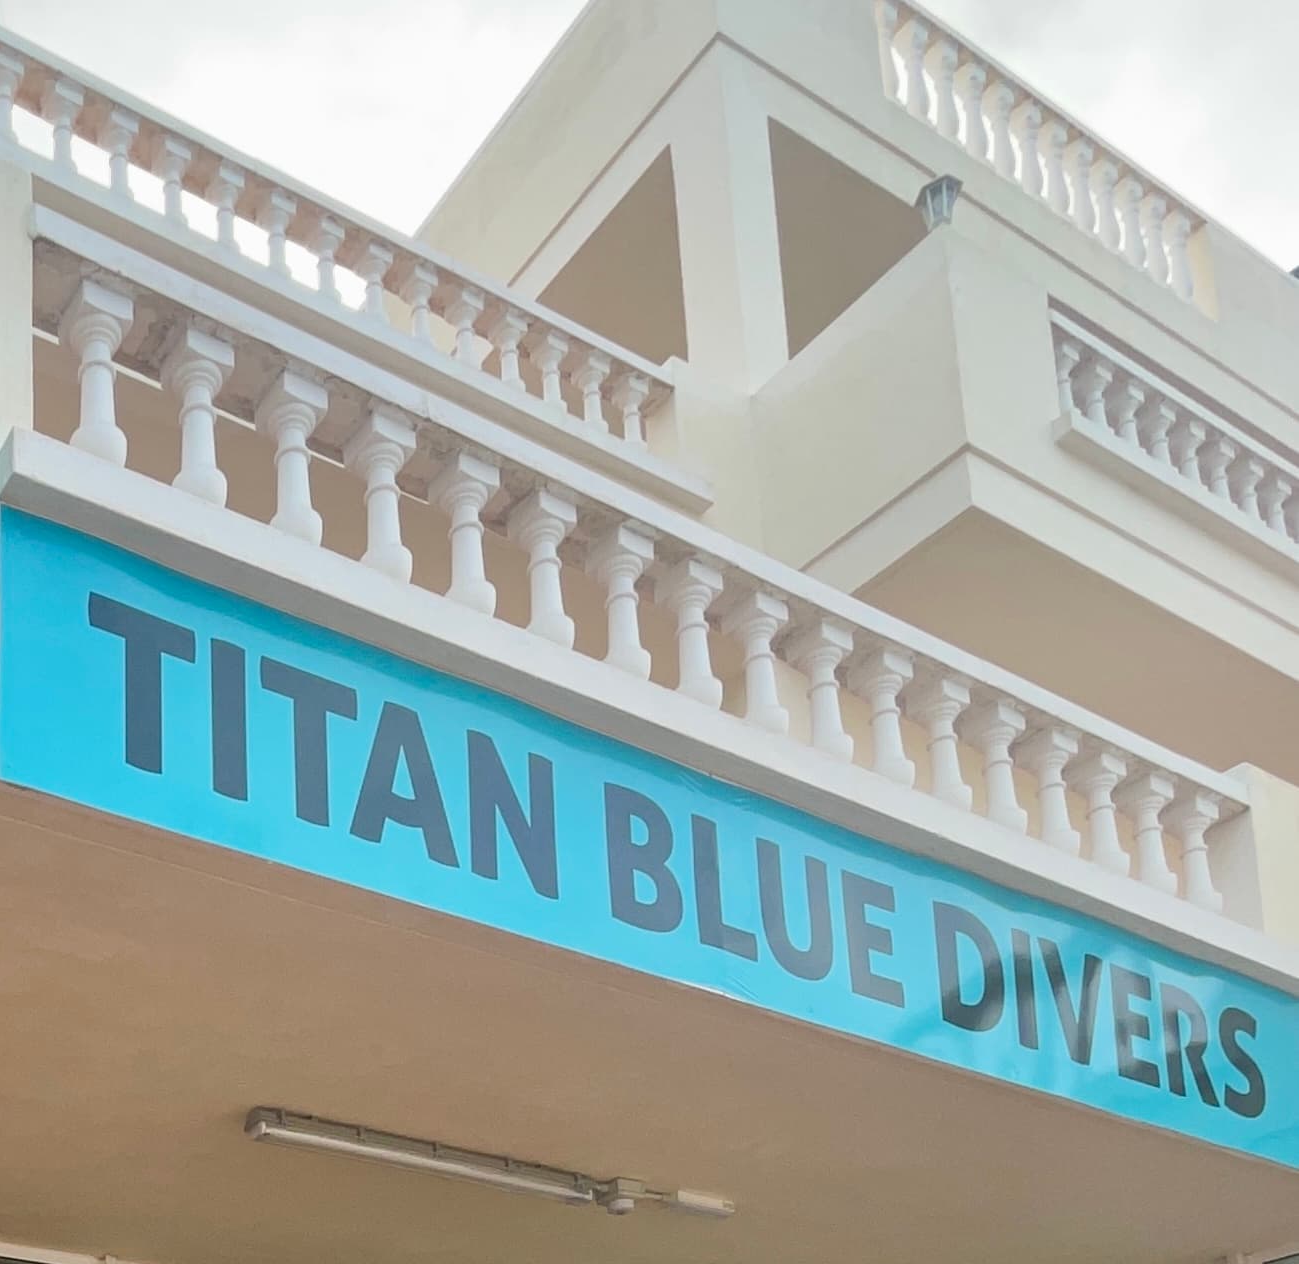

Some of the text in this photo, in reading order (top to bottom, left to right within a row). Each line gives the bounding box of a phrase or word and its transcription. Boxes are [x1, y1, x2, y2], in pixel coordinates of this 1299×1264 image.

[87, 591, 1267, 1119] TITAN BLUE DIVERS
